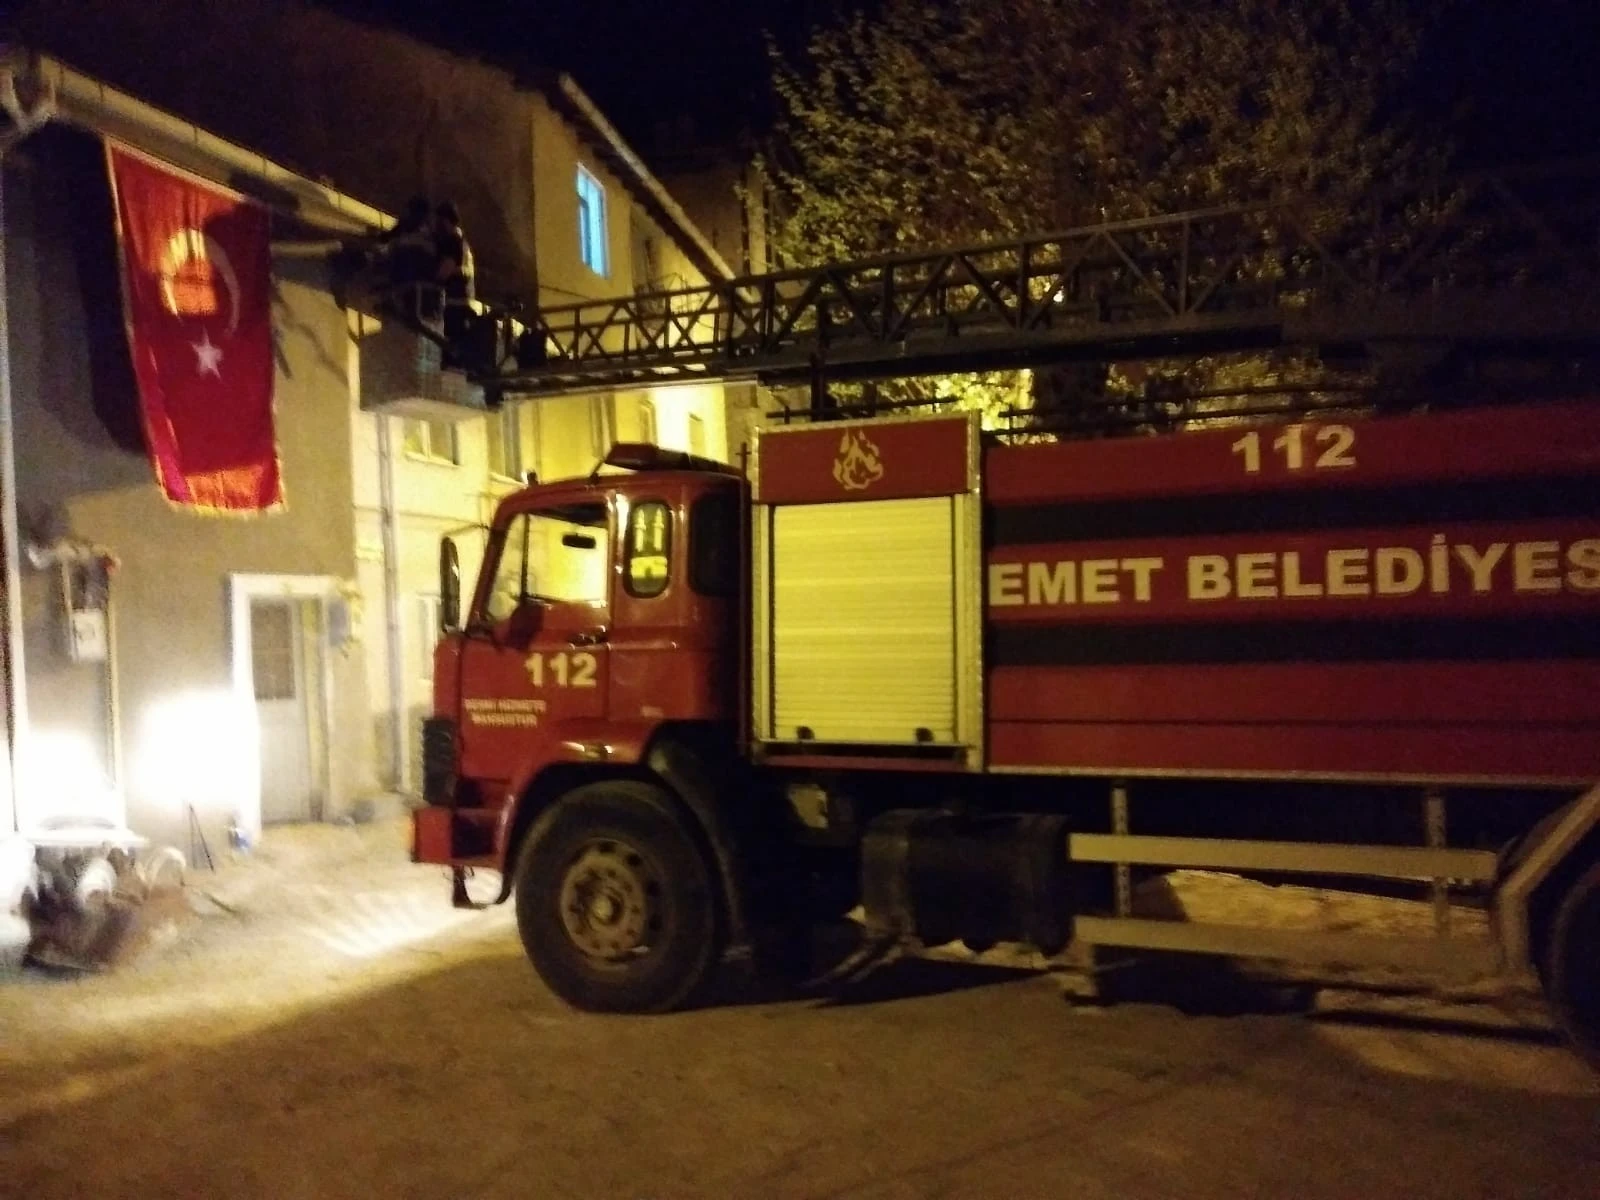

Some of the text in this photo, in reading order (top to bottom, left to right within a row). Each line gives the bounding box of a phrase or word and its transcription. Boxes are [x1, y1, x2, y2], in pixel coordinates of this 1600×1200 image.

[1232, 424, 1356, 472] 112
[989, 534, 1600, 606] EMET BELEDİYES
[524, 652, 597, 688] 112
